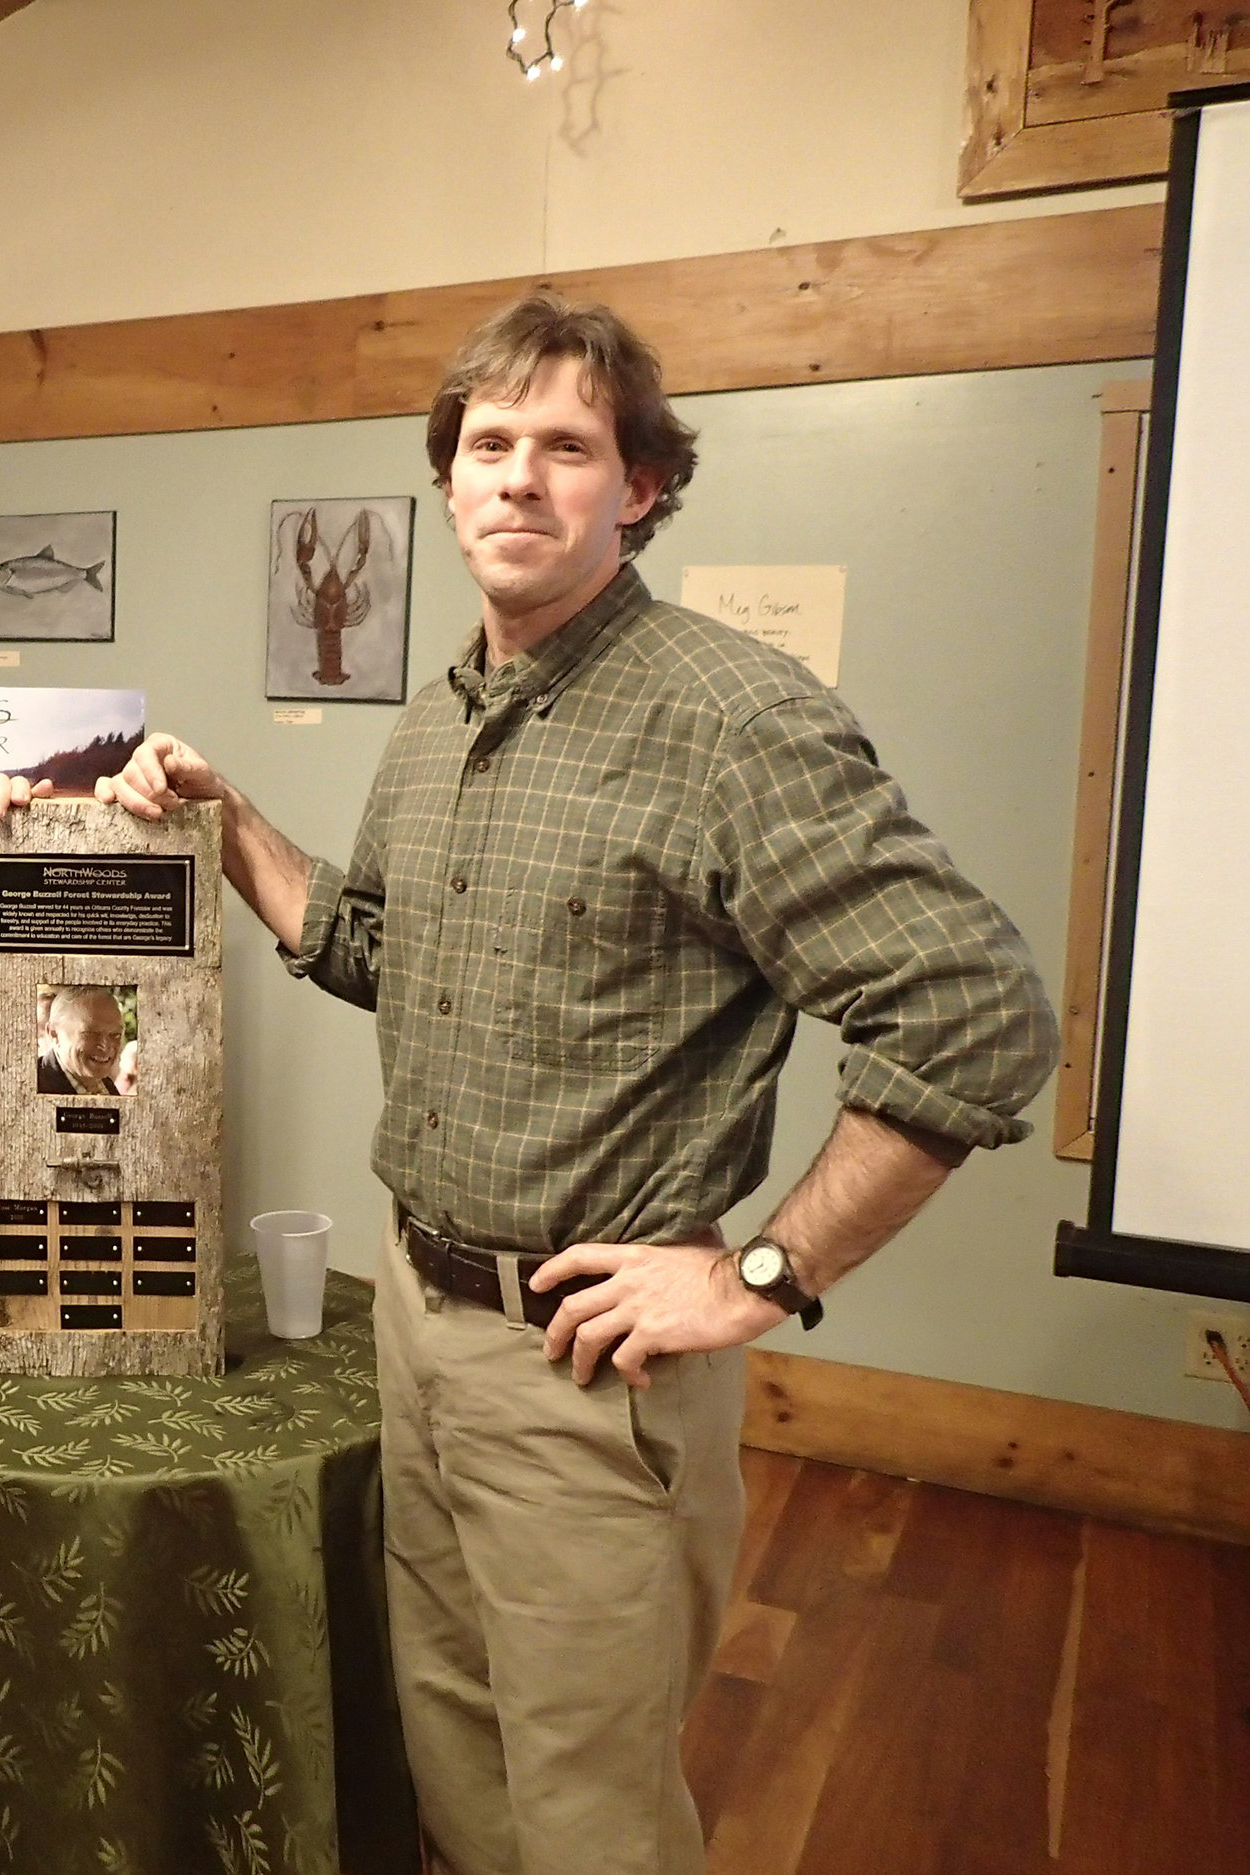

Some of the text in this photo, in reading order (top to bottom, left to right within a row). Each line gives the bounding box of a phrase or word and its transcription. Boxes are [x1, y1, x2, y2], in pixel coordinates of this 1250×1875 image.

[2, 890, 31, 899] George
[33, 890, 62, 898] Buzzell
[91, 892, 143, 900] Stewardship
